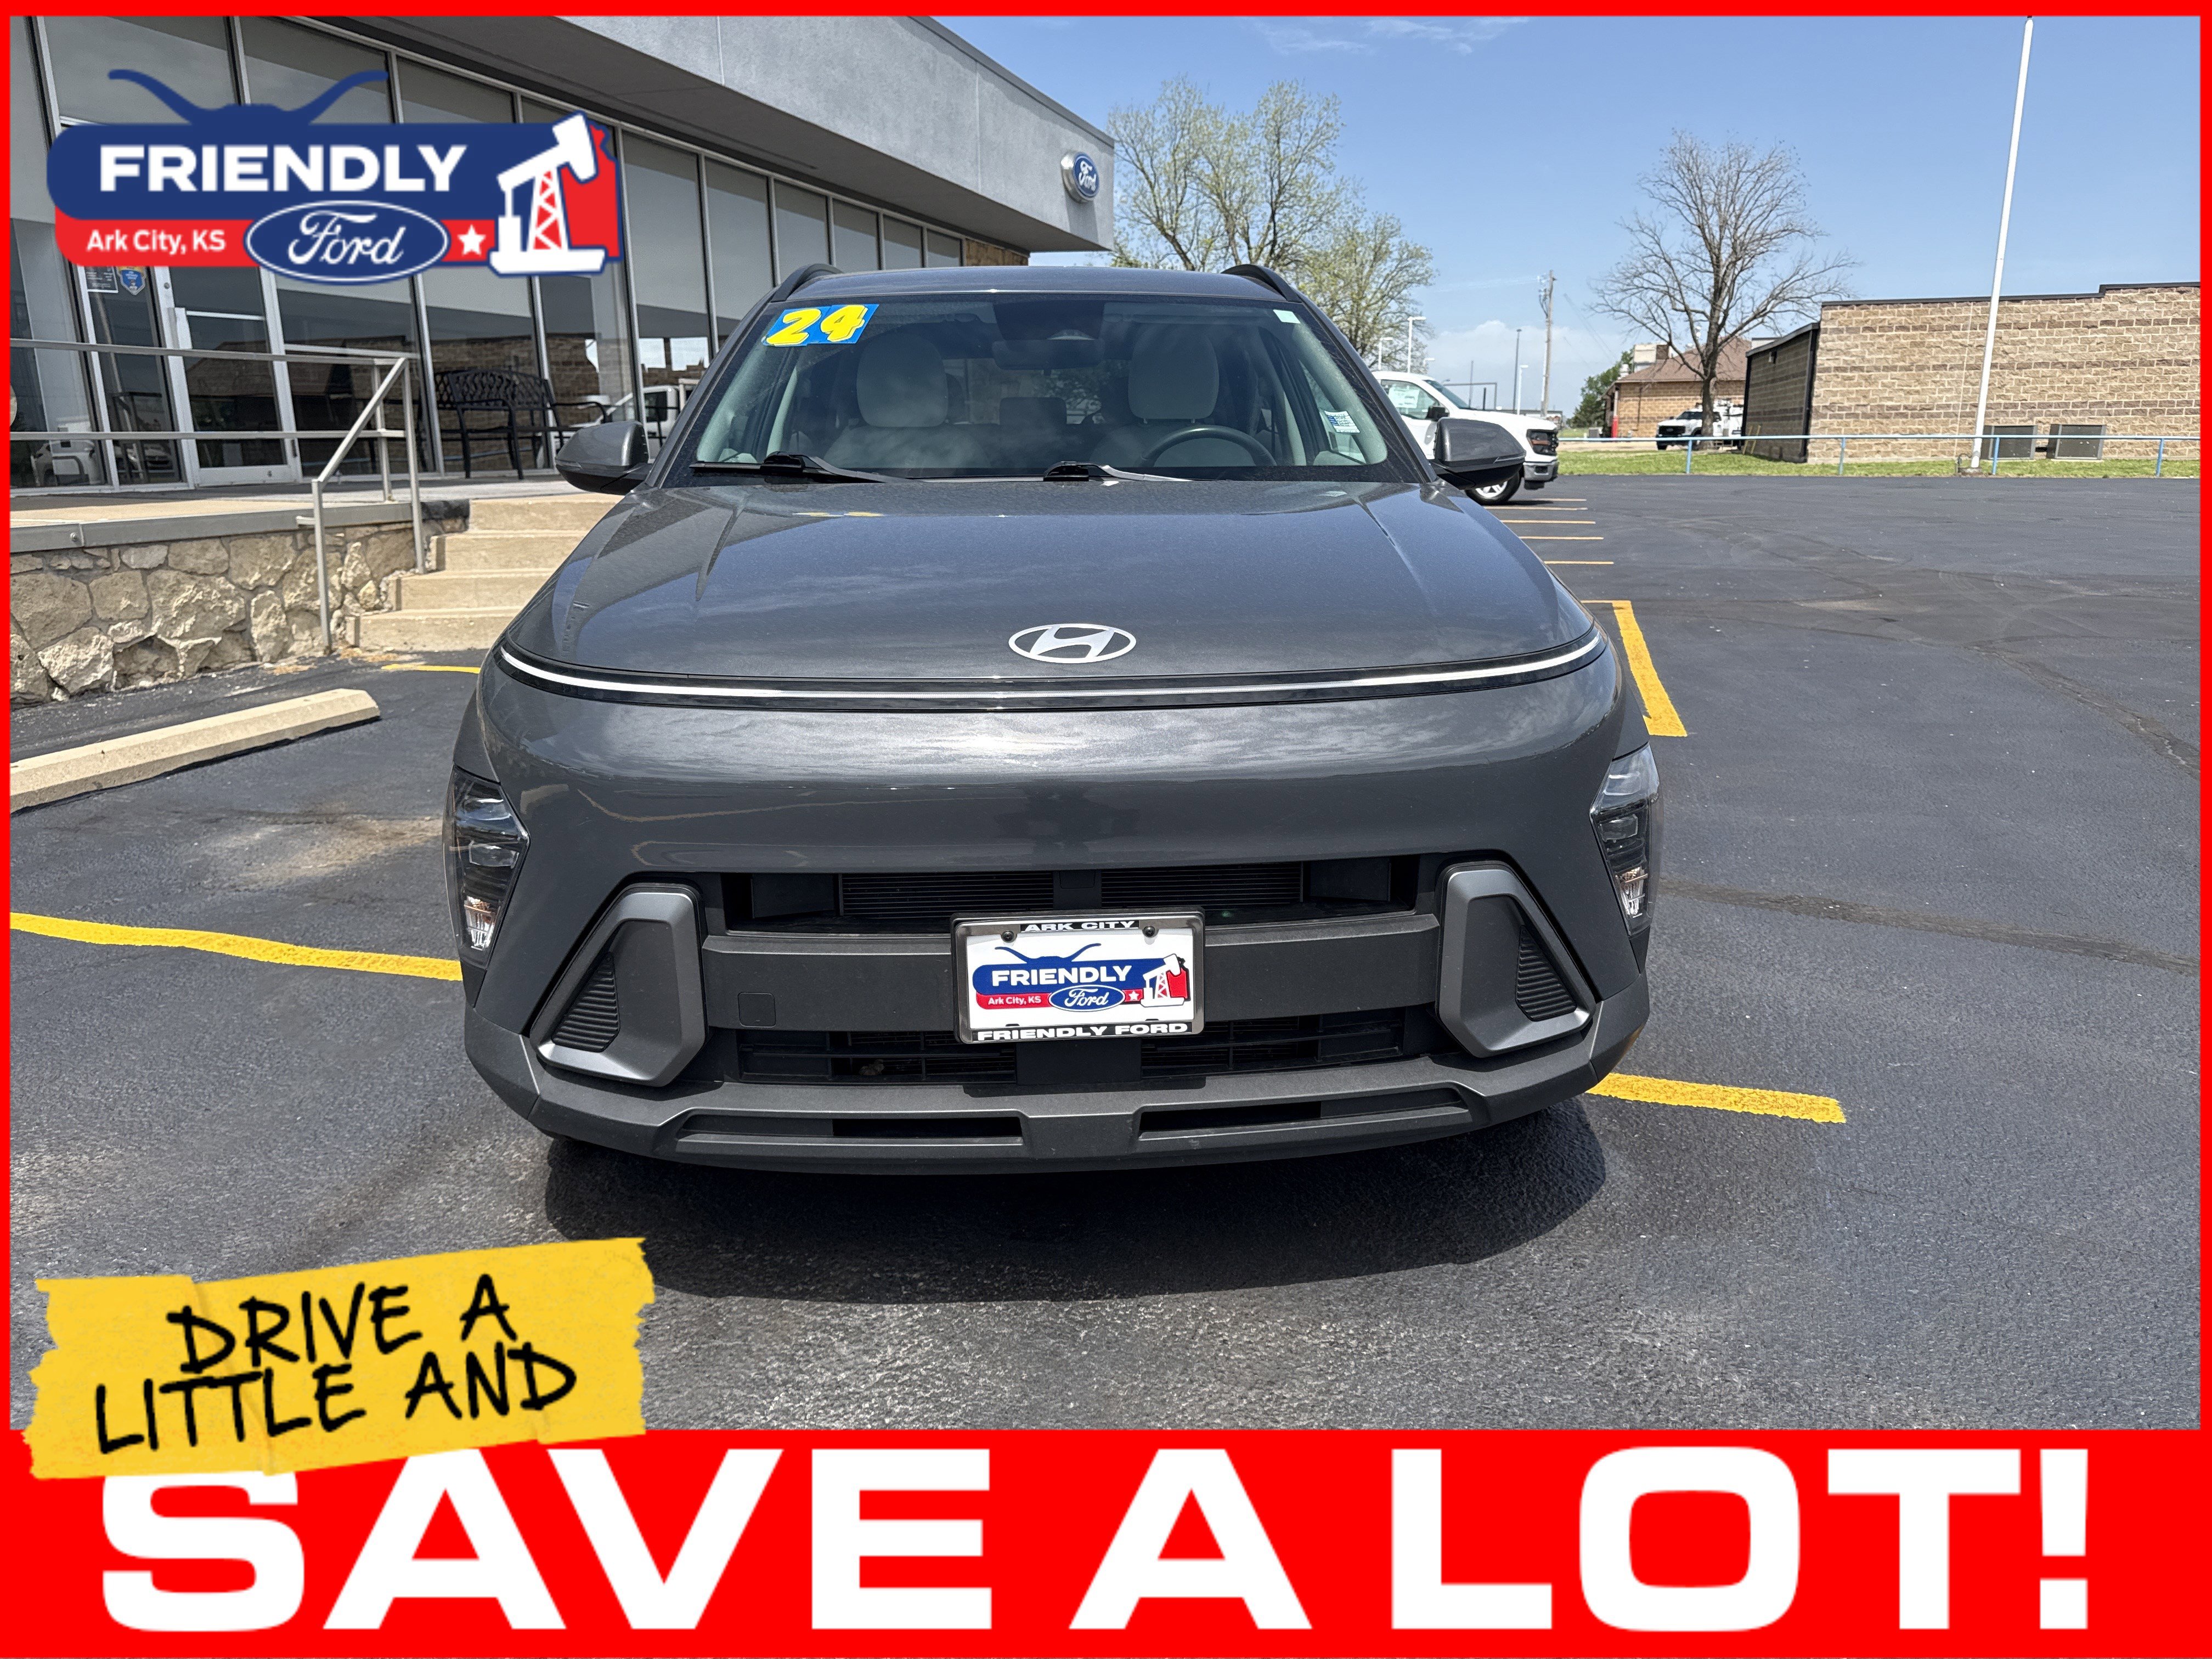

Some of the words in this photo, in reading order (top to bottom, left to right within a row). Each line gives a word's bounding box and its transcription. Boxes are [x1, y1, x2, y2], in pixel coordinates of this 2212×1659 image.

[1079, 160, 1097, 192] Ford
[766, 305, 868, 346] 24
[1025, 923, 1074, 932] ARK
[1081, 921, 1136, 930] CITY
[992, 966, 1133, 987] FRIENDLY
[988, 997, 1004, 1005] Ark
[1005, 996, 1028, 1006] City,
[1064, 988, 1109, 1008] Ford
[978, 1026, 1108, 1041] FRIENDLY
[1115, 1024, 1188, 1036] FORD
